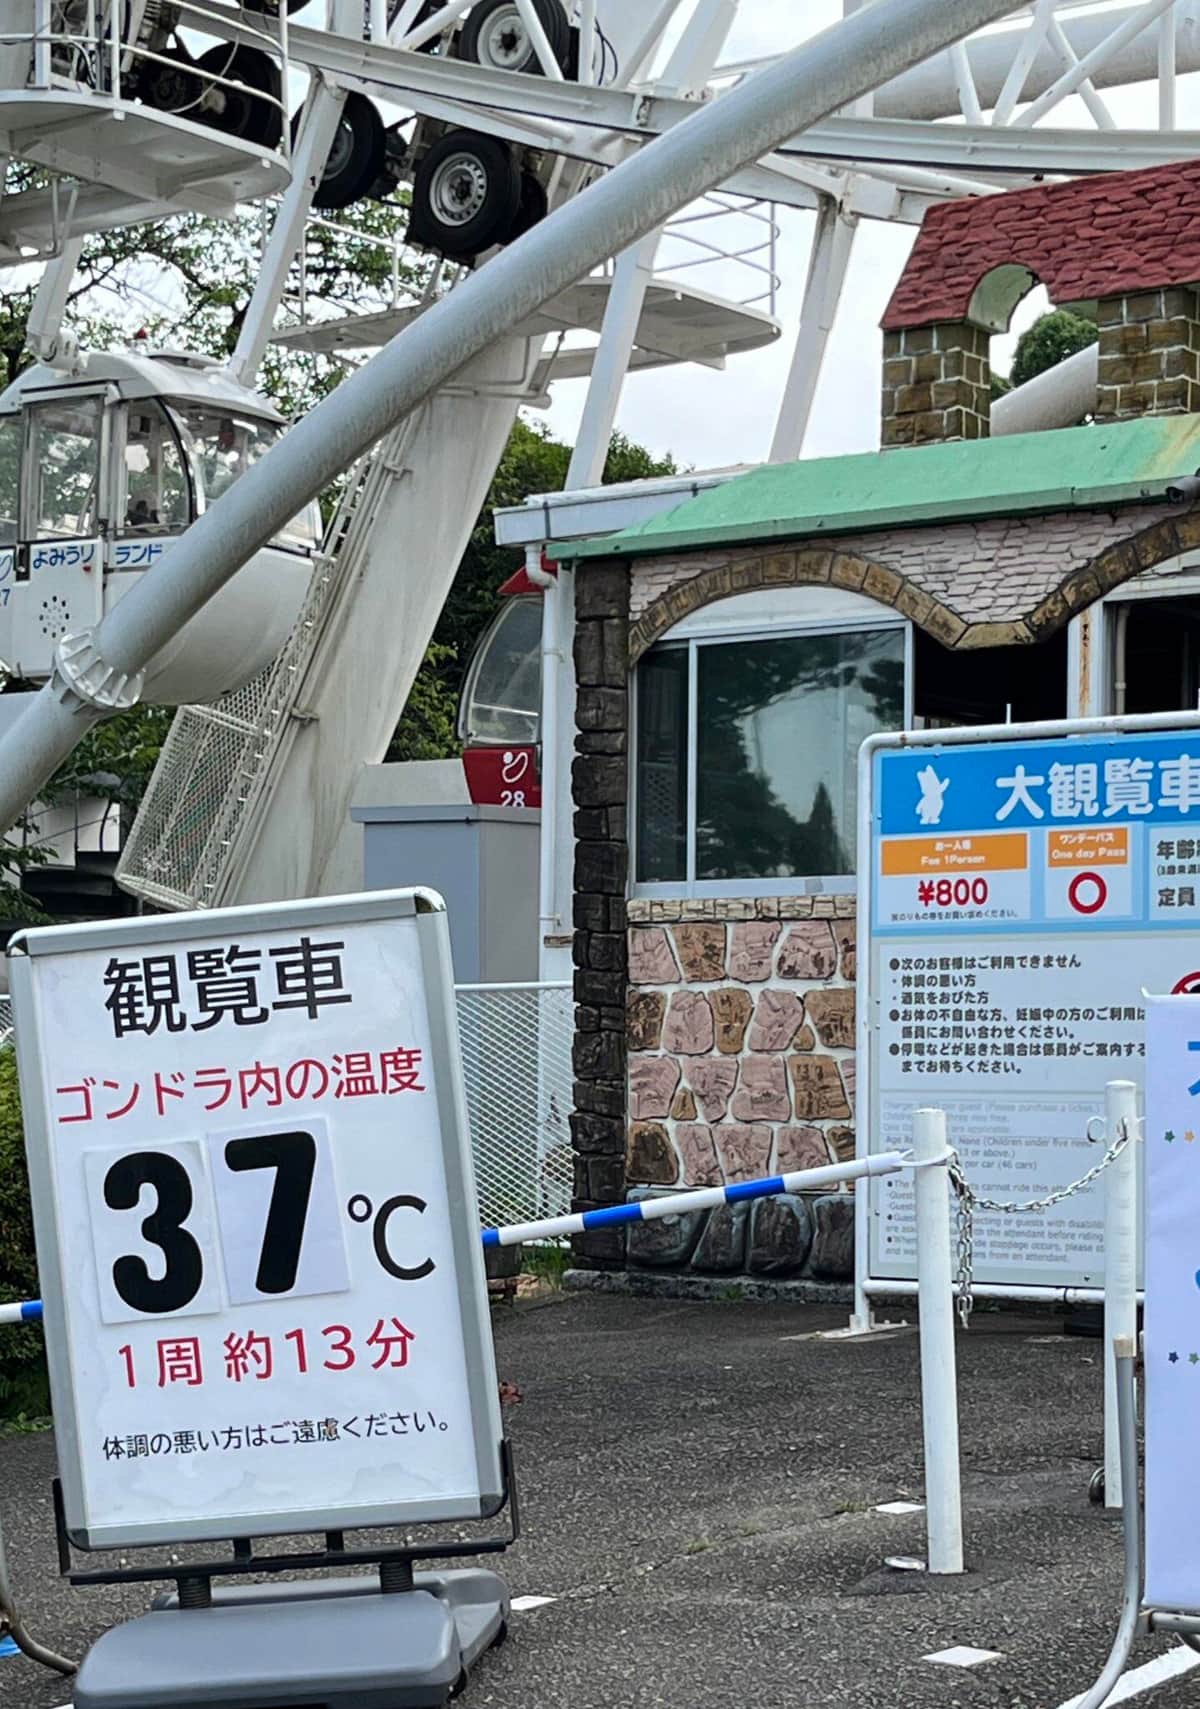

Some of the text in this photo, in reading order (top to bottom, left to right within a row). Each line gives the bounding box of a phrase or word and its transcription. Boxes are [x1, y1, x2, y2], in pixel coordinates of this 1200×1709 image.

[33, 543, 163, 569] よみうり ランド
[501, 790, 525, 807] 28
[995, 754, 1200, 821] 大観覧車
[1052, 849, 1072, 859] One
[1098, 847, 1126, 857] Pass
[1156, 839, 1200, 860] 年齢
[918, 877, 988, 907] ¥800
[104, 937, 351, 1038] 観覧車
[56, 1046, 426, 1123] ゴンドラ内の温度
[103, 1411, 449, 1461] 体調の悪い方はご遠慮ください。
